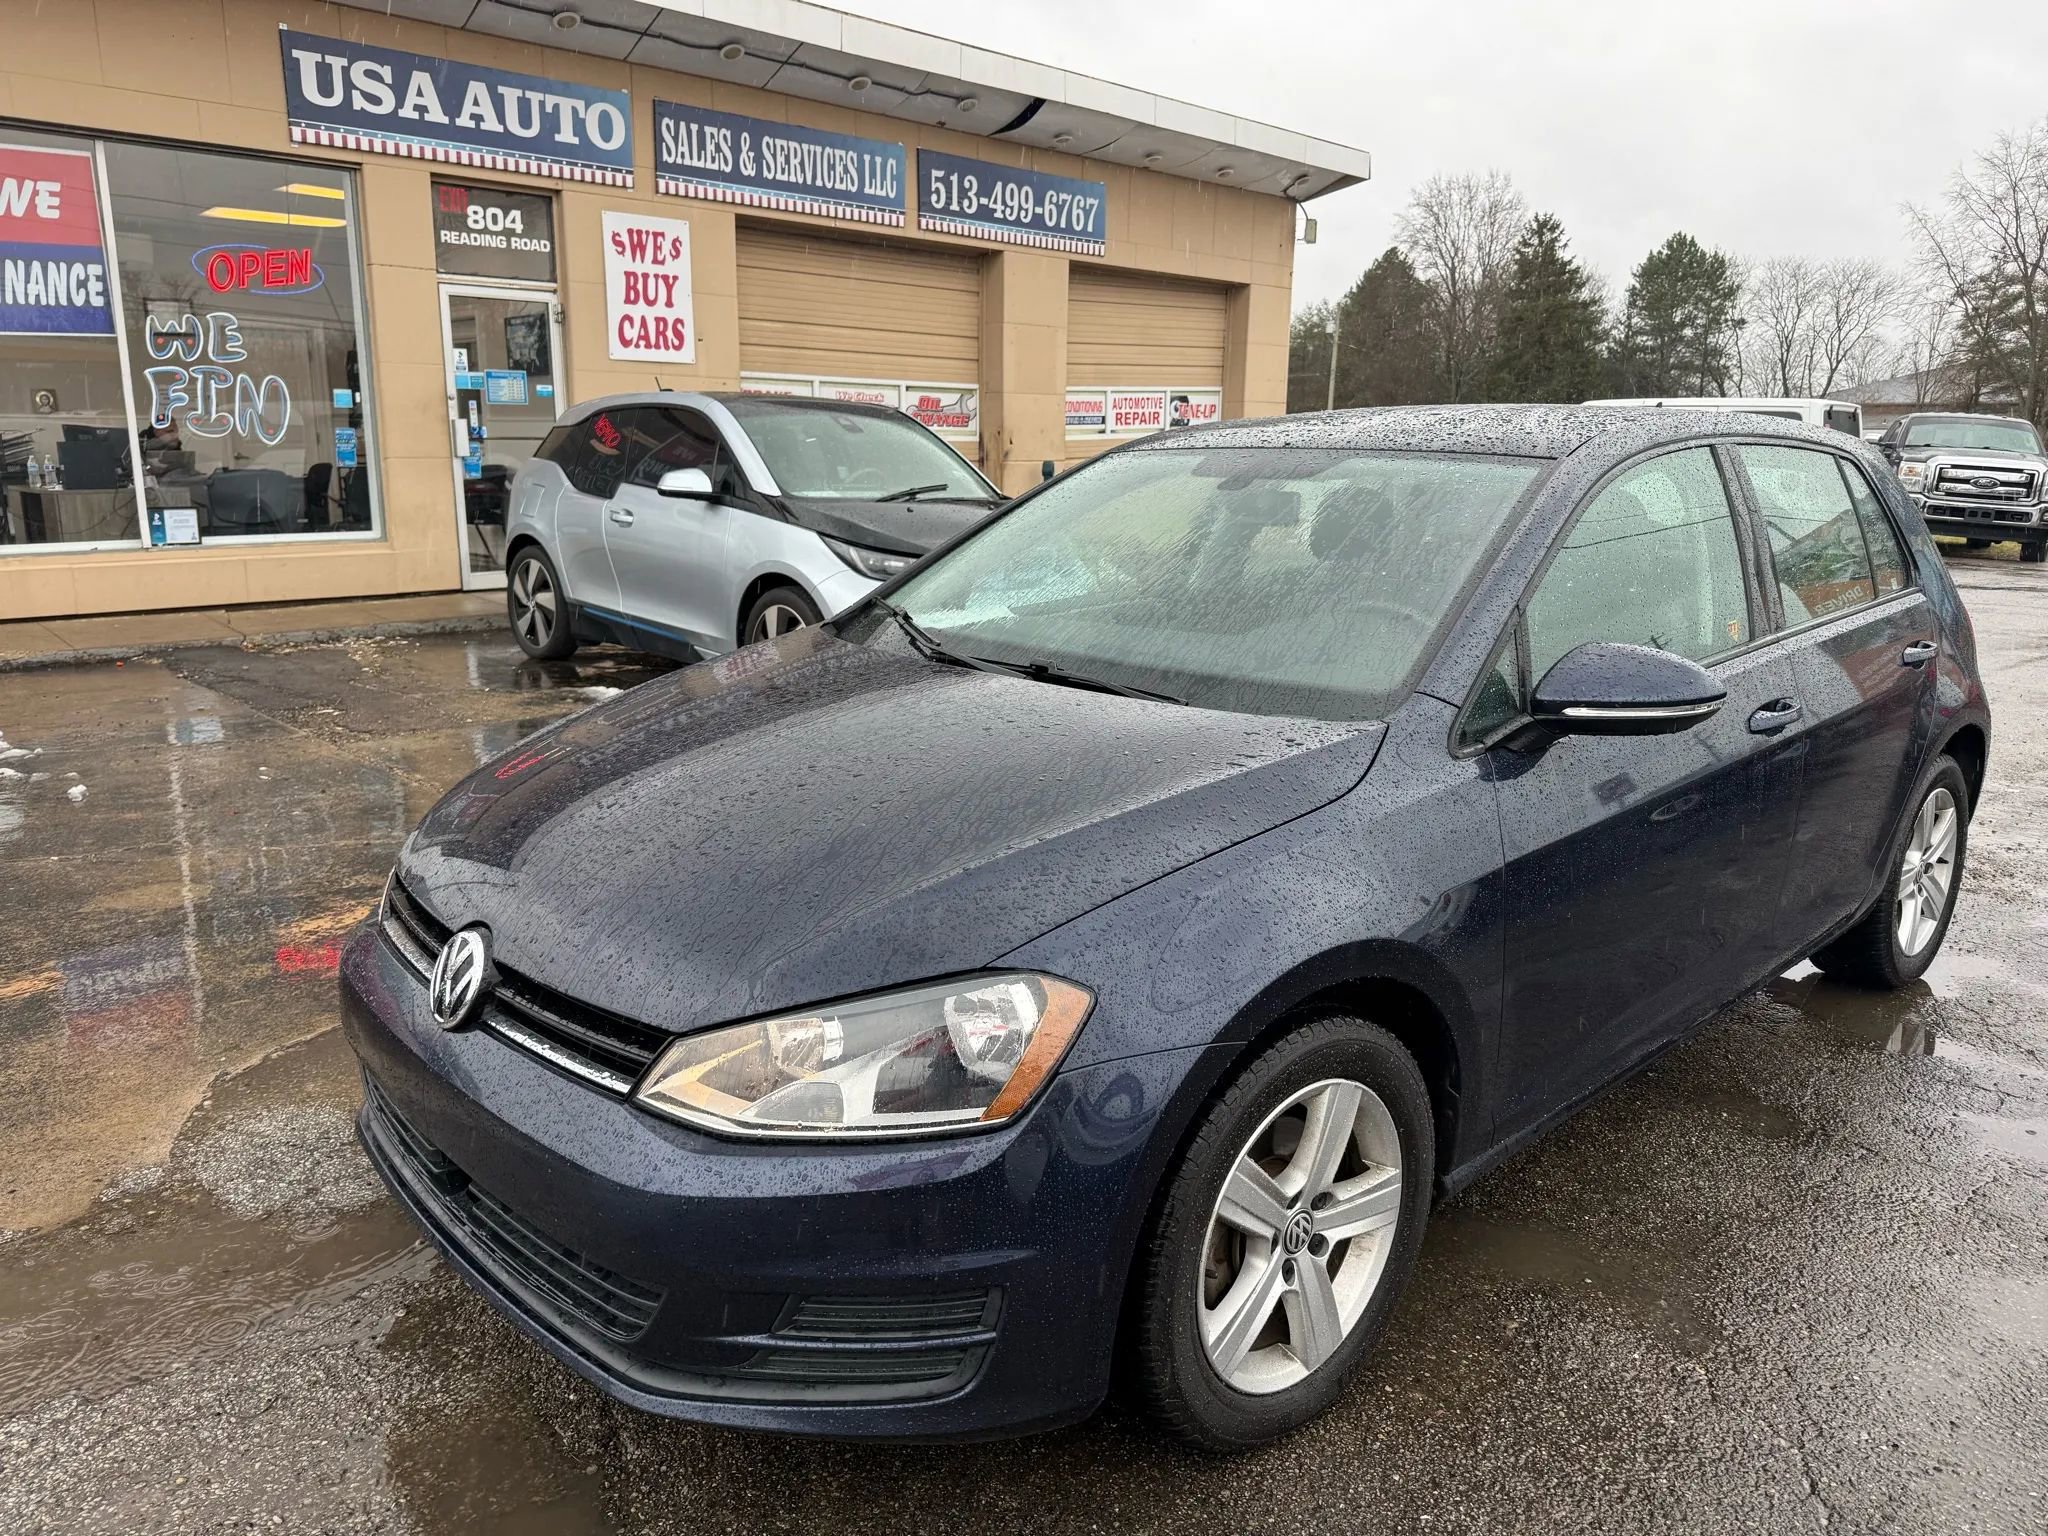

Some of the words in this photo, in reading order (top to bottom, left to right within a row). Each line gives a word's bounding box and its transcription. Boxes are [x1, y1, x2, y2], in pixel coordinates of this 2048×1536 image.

[292, 49, 450, 125] USA
[456, 80, 627, 151] AUTO
[661, 116, 733, 174] SALES
[739, 132, 756, 177] &
[761, 135, 859, 193] SERVICES
[863, 153, 897, 199] LLC
[0, 177, 61, 219] WE
[930, 168, 1099, 233] 513-499-6767
[466, 205, 524, 234] 804
[440, 230, 507, 249] READING
[510, 236, 551, 253] ROAD
[4, 258, 105, 307] NANCE
[206, 248, 311, 294] OPEN
[623, 270, 679, 309] BUY
[146, 312, 248, 363] WE
[617, 313, 685, 352] CARS
[144, 365, 290, 446] FIN
[917, 396, 944, 412] OIL
[1112, 396, 1163, 411] AUTOMOTIVE
[1115, 411, 1160, 426] REPAIR
[1178, 403, 1217, 419] TUNE-UP
